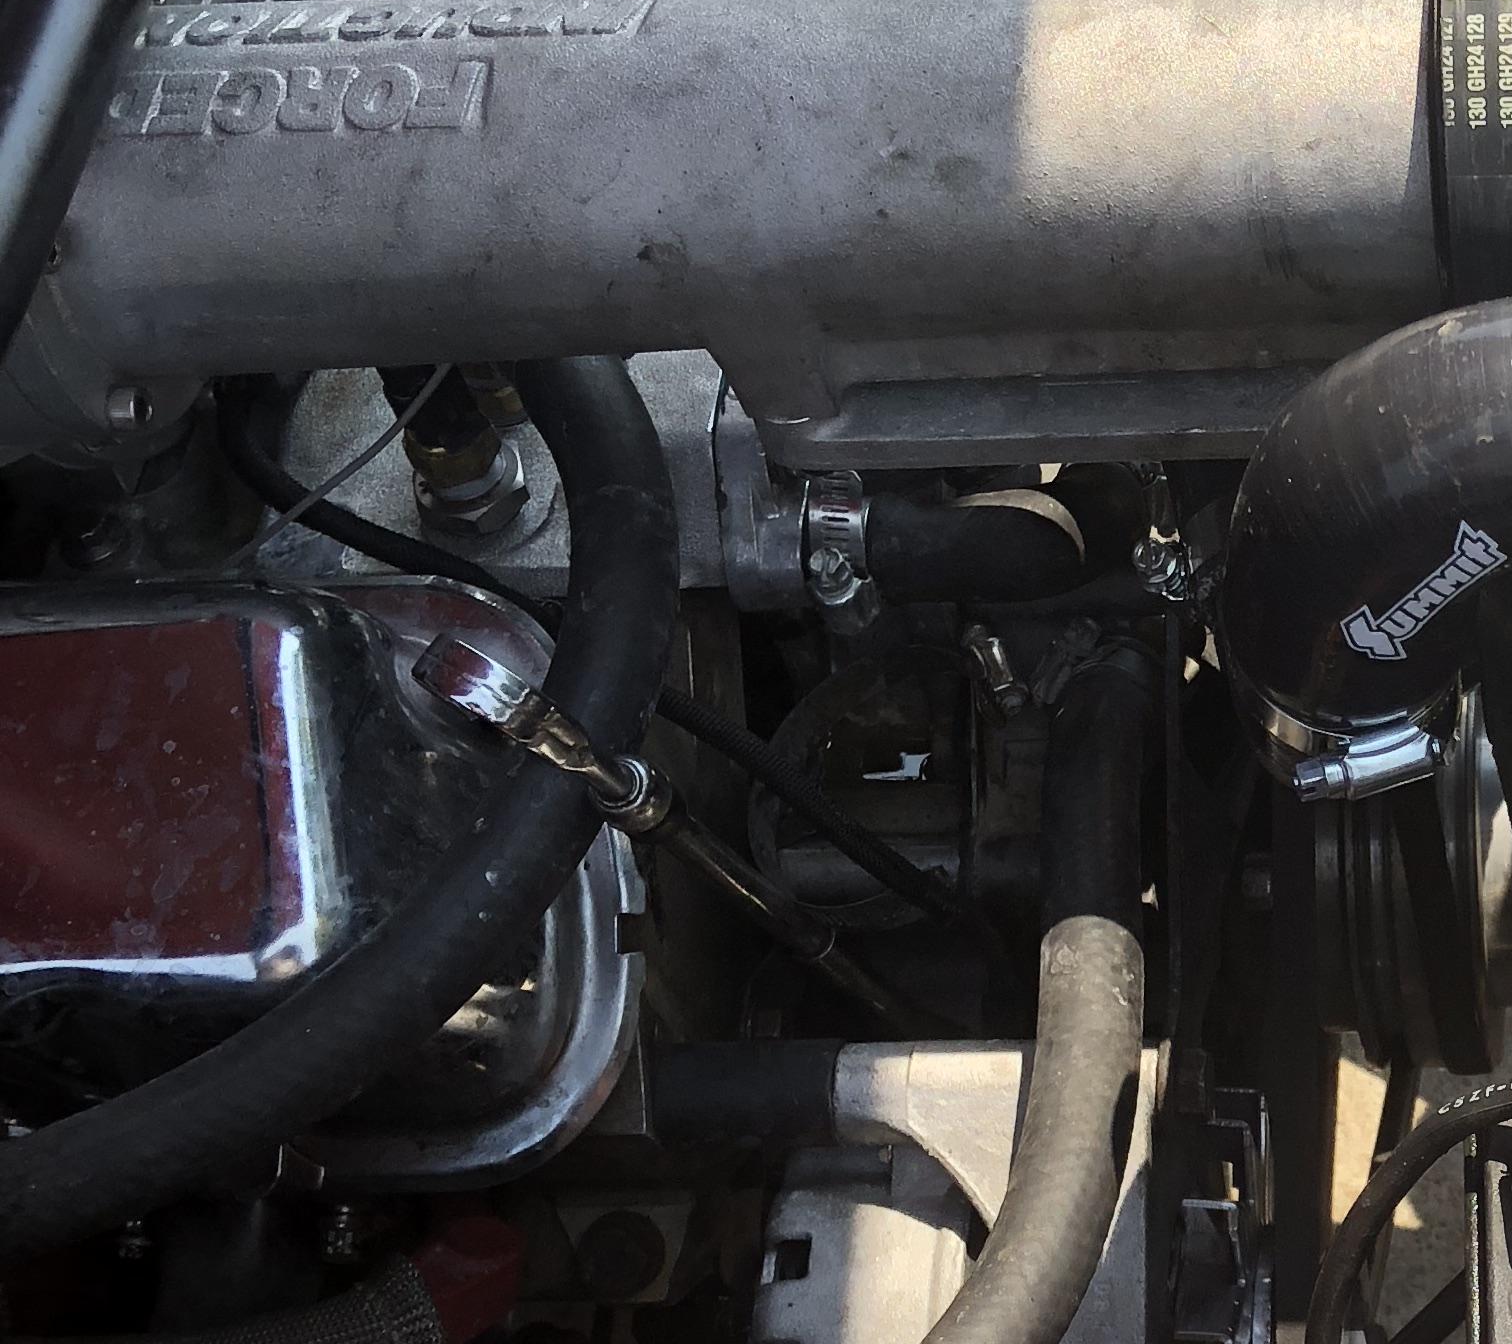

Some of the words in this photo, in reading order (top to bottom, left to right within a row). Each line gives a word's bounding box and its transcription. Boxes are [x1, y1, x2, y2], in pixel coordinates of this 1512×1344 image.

[1466, 13, 1485, 43] 128
[1467, 44, 1486, 92] GH24
[1468, 97, 1487, 130] 130
